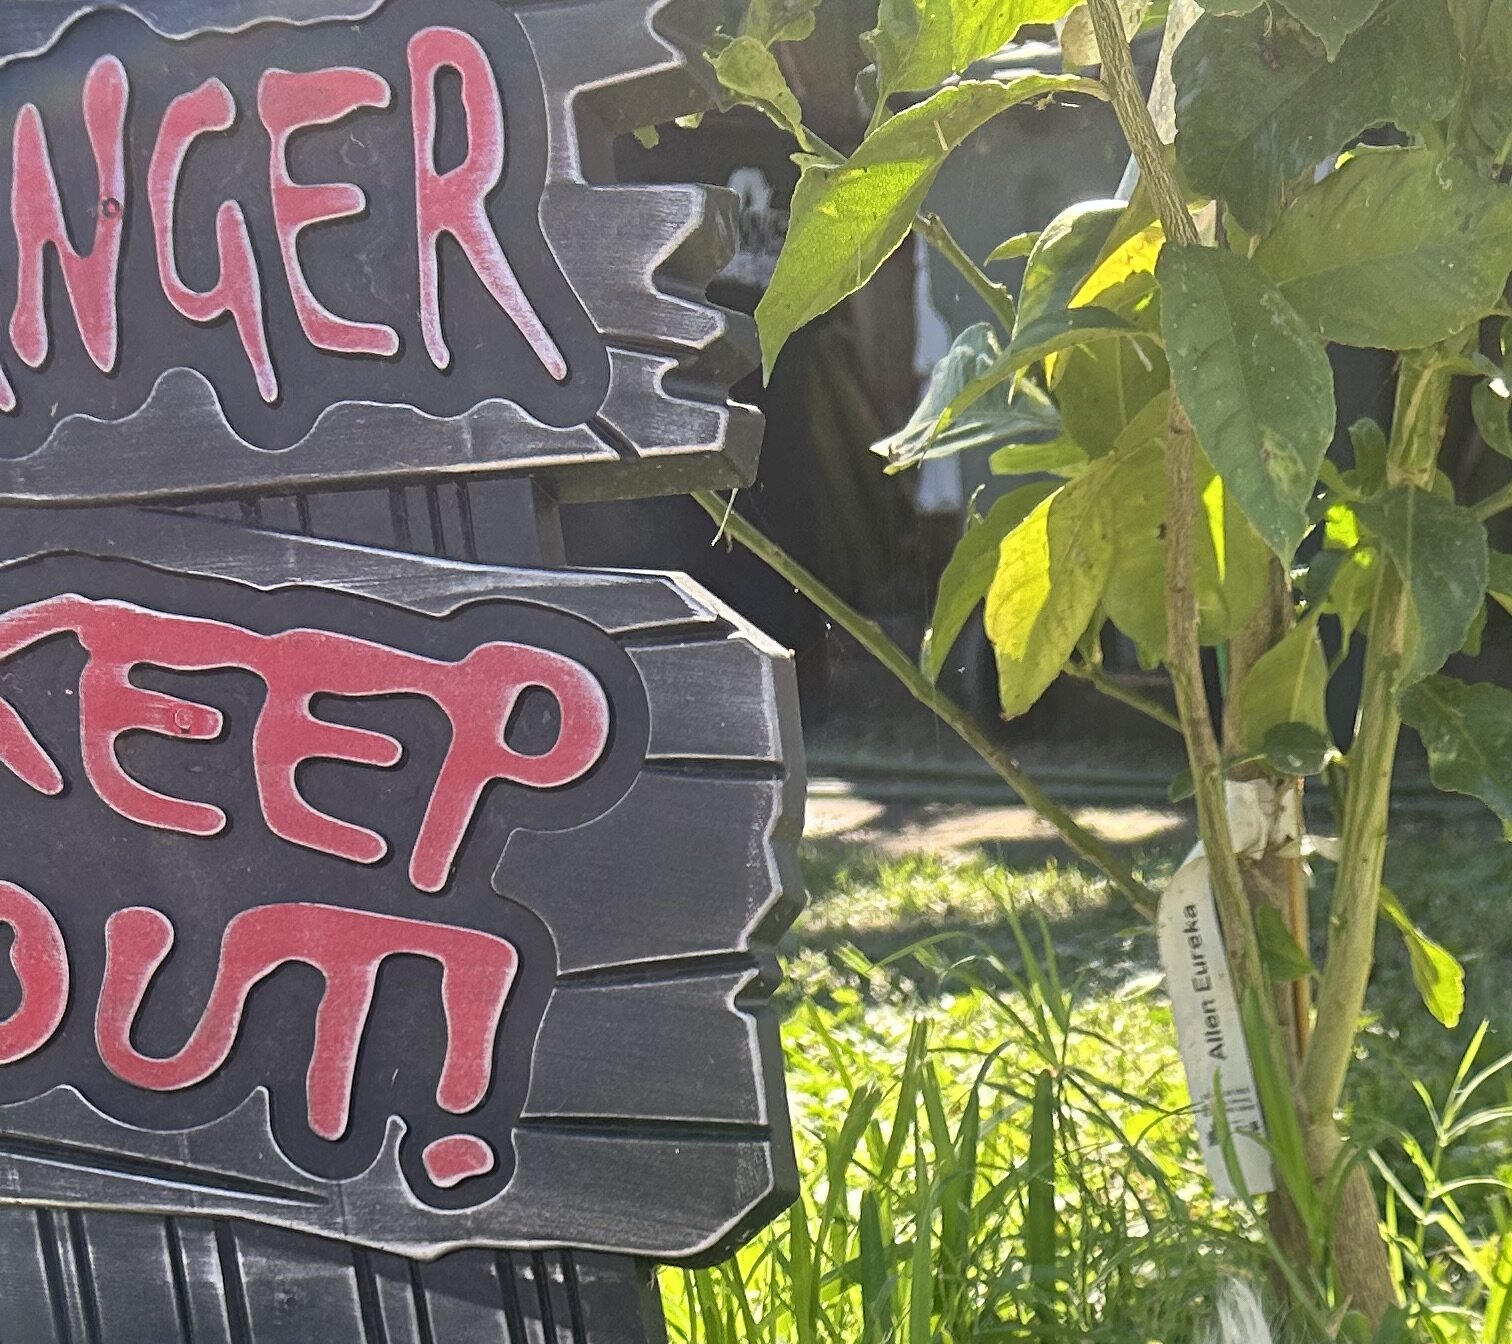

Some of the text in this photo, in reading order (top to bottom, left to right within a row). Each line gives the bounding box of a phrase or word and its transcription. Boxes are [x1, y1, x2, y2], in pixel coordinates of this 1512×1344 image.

[0, 25, 568, 411] NGER
[1183, 904, 1228, 1061] Allen Eureka
